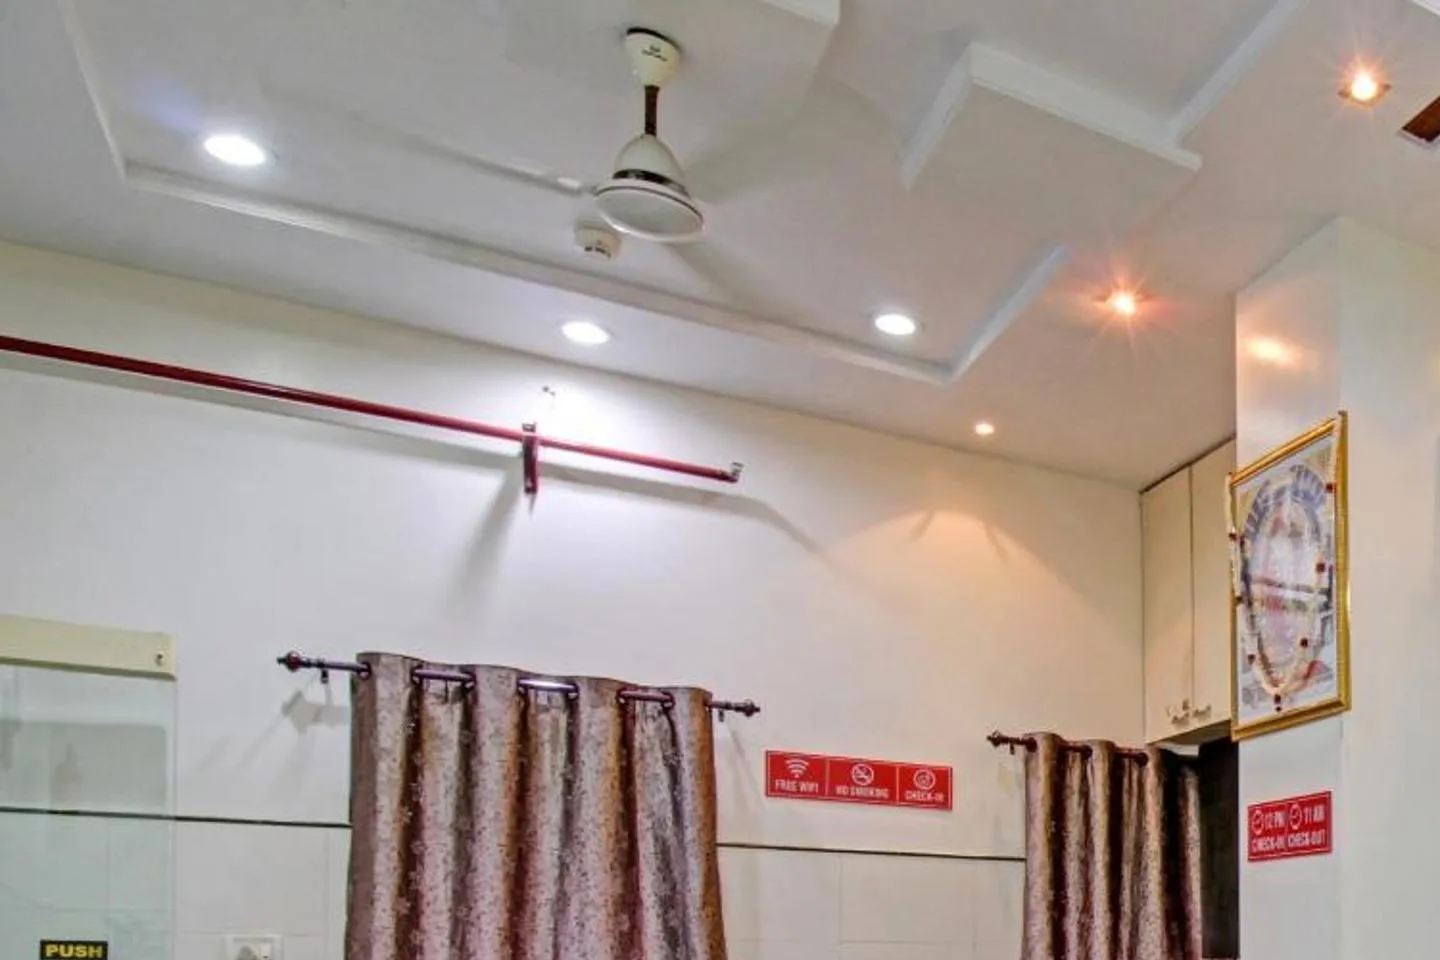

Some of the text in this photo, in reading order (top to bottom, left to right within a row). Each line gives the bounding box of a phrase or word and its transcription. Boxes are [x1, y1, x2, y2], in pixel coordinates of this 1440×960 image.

[775, 779, 797, 792] FREE
[835, 785, 889, 799] NO SMOKING
[904, 790, 945, 803] CHECK-IN
[45, 944, 103, 958] PUSH
